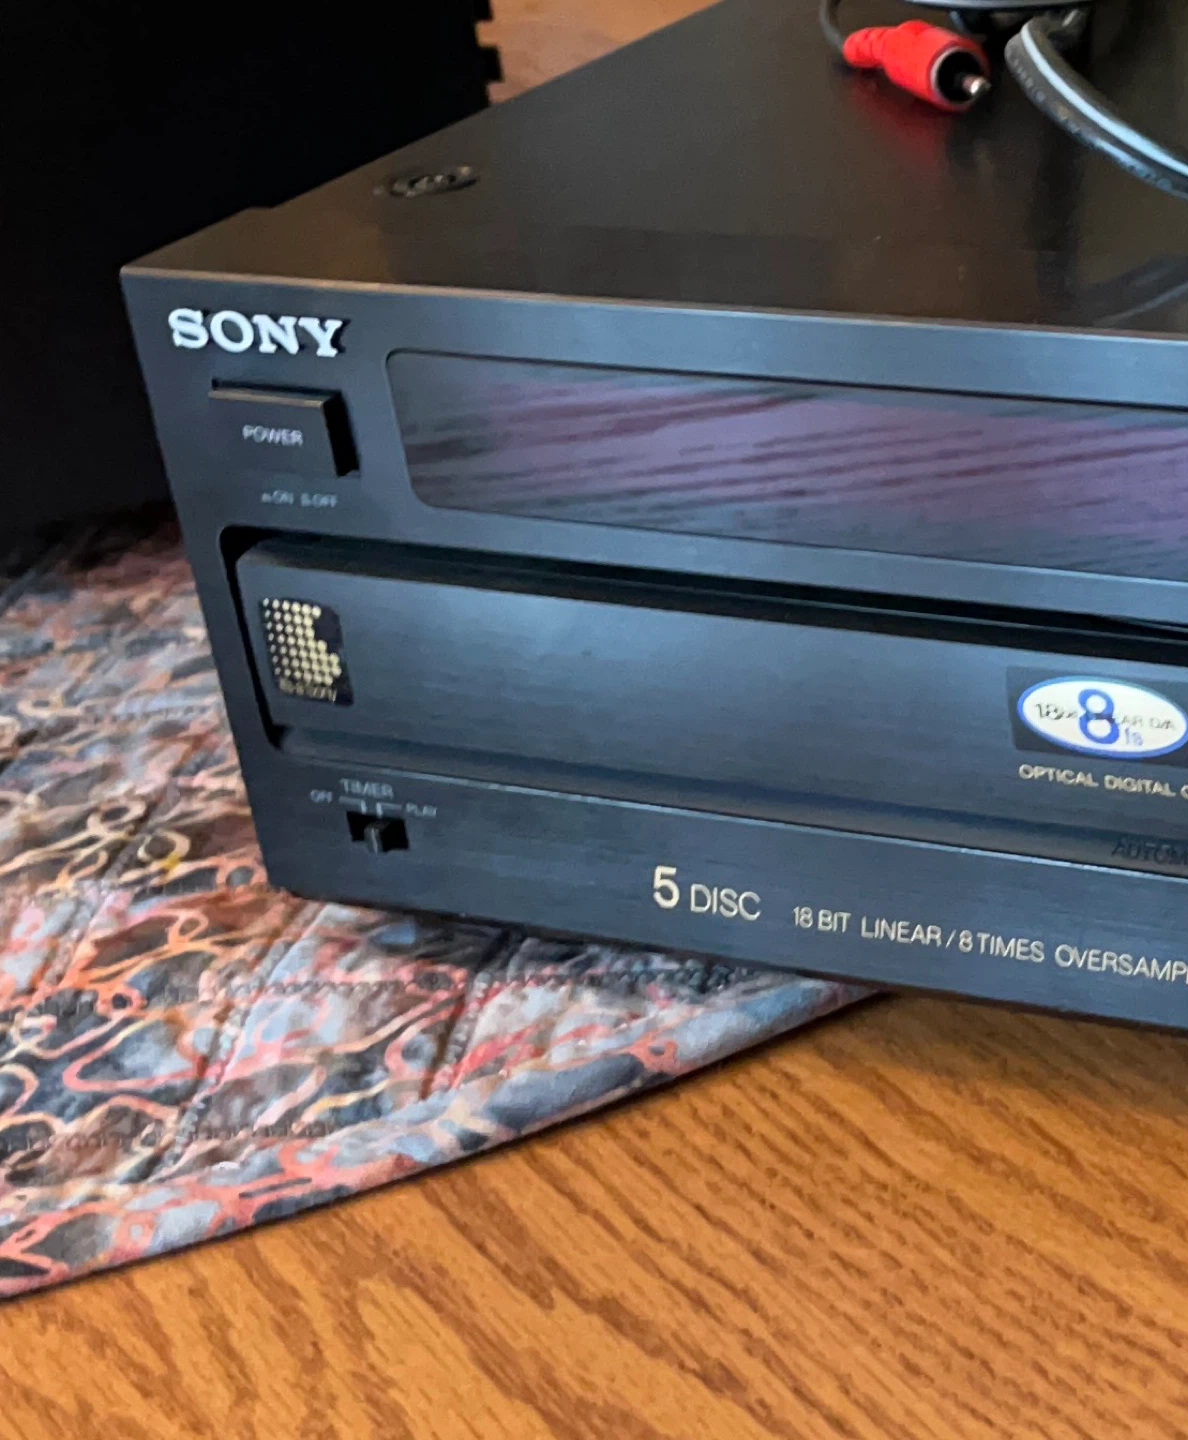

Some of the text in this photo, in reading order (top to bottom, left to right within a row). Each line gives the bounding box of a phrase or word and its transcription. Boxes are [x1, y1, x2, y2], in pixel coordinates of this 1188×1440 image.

[168, 308, 343, 358] SONY
[242, 424, 303, 447] POWER
[340, 777, 394, 800] TIMER
[1019, 764, 1099, 788] OPTICAL
[1104, 774, 1176, 798] DIGITAL
[653, 866, 762, 922] 5 DISC
[818, 910, 850, 933] BIT
